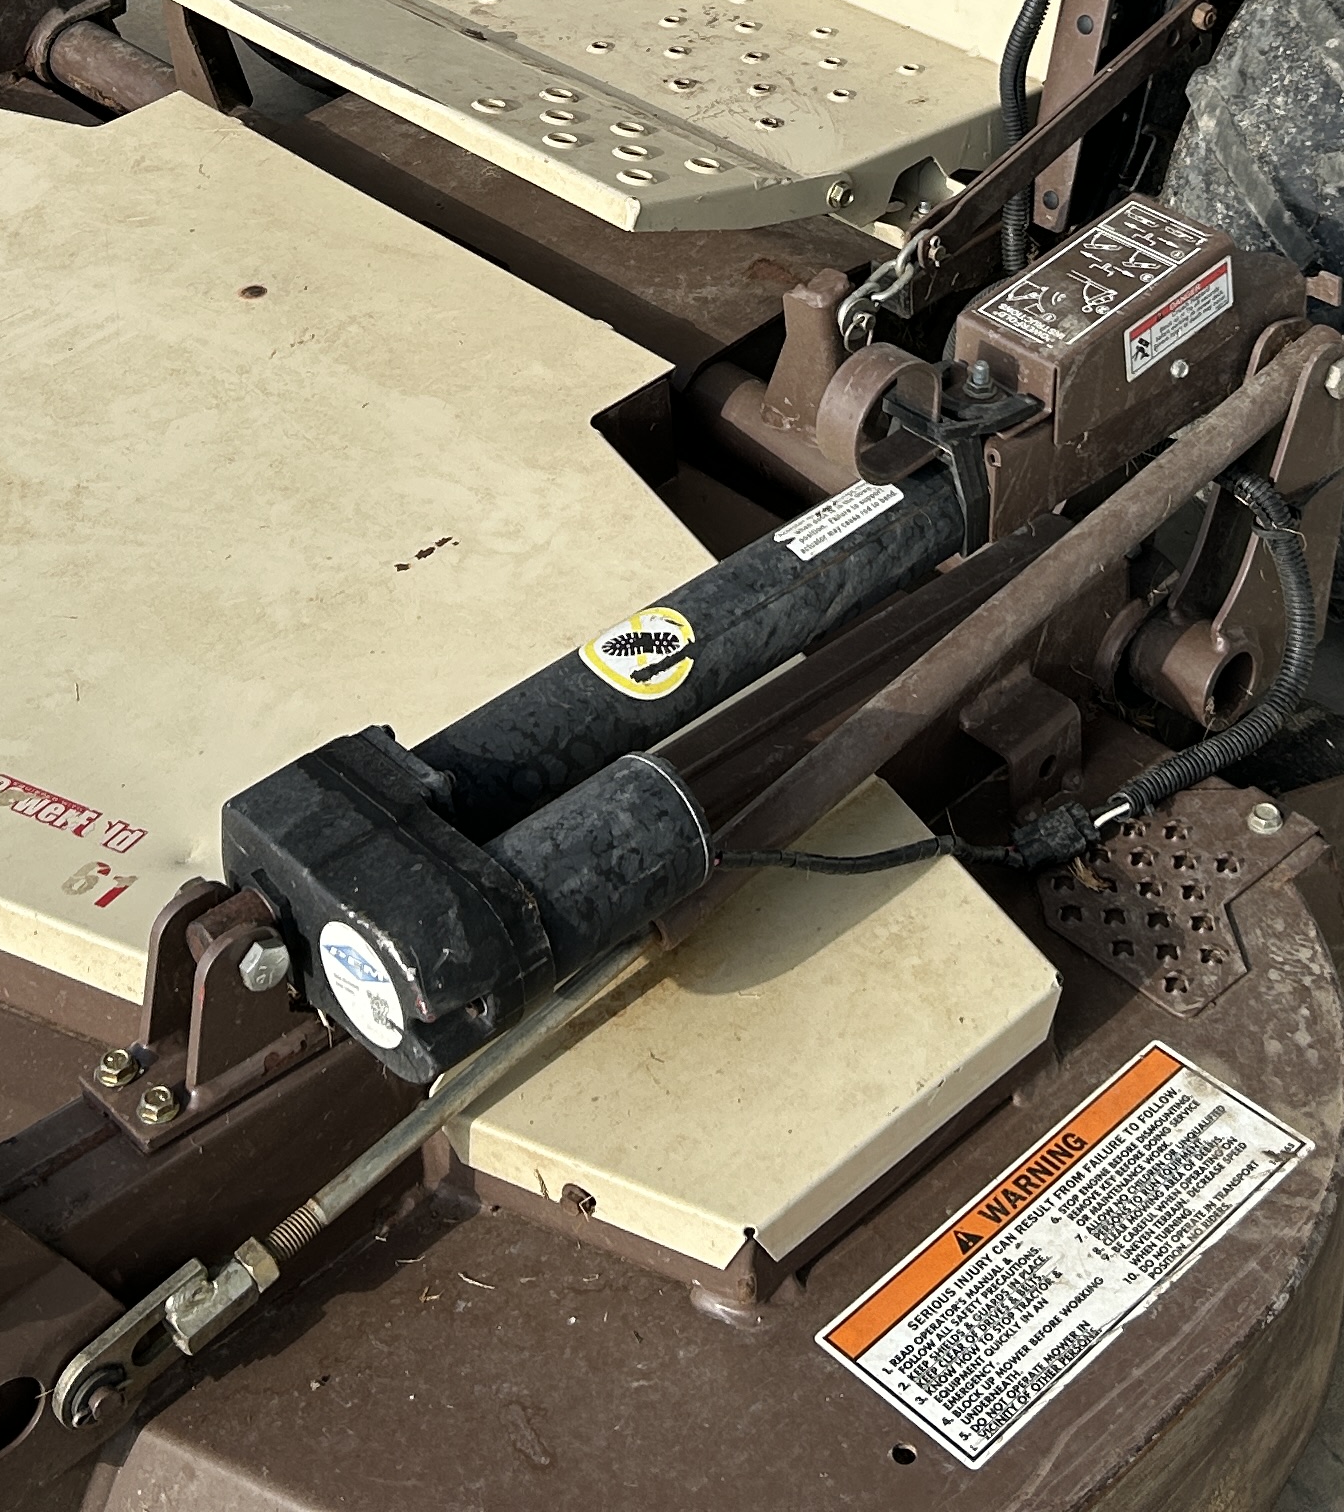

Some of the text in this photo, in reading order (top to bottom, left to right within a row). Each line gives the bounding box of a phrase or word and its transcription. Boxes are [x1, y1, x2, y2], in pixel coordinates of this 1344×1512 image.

[1169, 282, 1200, 311] DANGER
[61, 861, 139, 909] 61
[976, 1130, 1088, 1226] WARNING
[1056, 1193, 1082, 1214] STOP
[1077, 1166, 1111, 1195] ENGINE
[1106, 1141, 1139, 1169] BEFORE
[1065, 1099, 1201, 1221] REMOVE KEY BEFORE DOING SERVICE
[1074, 1213, 1091, 1227] OR
[1087, 1163, 1146, 1215] MAINTENANCE
[1083, 1205, 1116, 1234] ALLOW
[1111, 1192, 1130, 1209] NO
[1125, 1159, 1167, 1196] CHILDREN
[1162, 1148, 1179, 1162] OR
[1099, 1221, 1129, 1247] CLEAR
[1123, 1188, 1165, 1224] MOWING
[1160, 1169, 1186, 1191] AREA
[1181, 1158, 1197, 1172] OF
[1110, 1136, 1238, 1253] BE CAREFUL WHEN OPERATING ON
[1119, 1227, 1156, 1260] UNEVEN
[1185, 1162, 1225, 1198] DECREASE
[1221, 1140, 1248, 1164] SPEED
[906, 1286, 957, 1331] SERIOUS
[952, 1253, 994, 1289] INJURY
[990, 1232, 1017, 1255] CAN
[1013, 1197, 1056, 1235] RESULT
[1051, 1170, 1086, 1200] FROM
[1081, 1134, 1126, 1173] FAILURE
[1121, 1121, 1140, 1136] TO
[1091, 1204, 1133, 1241] PERSONS
[1126, 1193, 1145, 1208] TO
[1138, 1177, 1162, 1197] RUN
[1128, 1240, 1158, 1266] WHEN
[1137, 1159, 1260, 1273] DO NOT OPERATE IN TRANSPORT
[1185, 1226, 1205, 1242] NO
[888, 1263, 1004, 1367] READ OPERATOR'S MANUAL
[897, 1338, 937, 1374] FOLLOW
[933, 1324, 953, 1341] ALL
[949, 1297, 983, 1327] SAFETY
[906, 1358, 932, 1382] KEEP
[928, 1328, 966, 1362] SHIELDS
[970, 1287, 1011, 1323] GUARDS
[1006, 1277, 1023, 1291] IN
[914, 1365, 941, 1389] KEEP
[936, 1341, 968, 1369] CLEAR
[962, 1329, 981, 1345] OF
[976, 1302, 1011, 1333] DRIVES
[922, 1276, 1055, 1396] KNOW HOW TO STOP TRACTOR
[932, 1296, 1049, 1403] EQUIPMENT QUICKLY IN AN
[950, 1275, 1105, 1418] BLOCK UP MOWER BEFORE WORKING
[969, 1319, 1092, 1433] DO NOT OPERATE MOWER IN
[977, 1401, 1020, 1440] VICINITY
[1014, 1389, 1033, 1405] OF
[1027, 1362, 1062, 1393] OTHER
